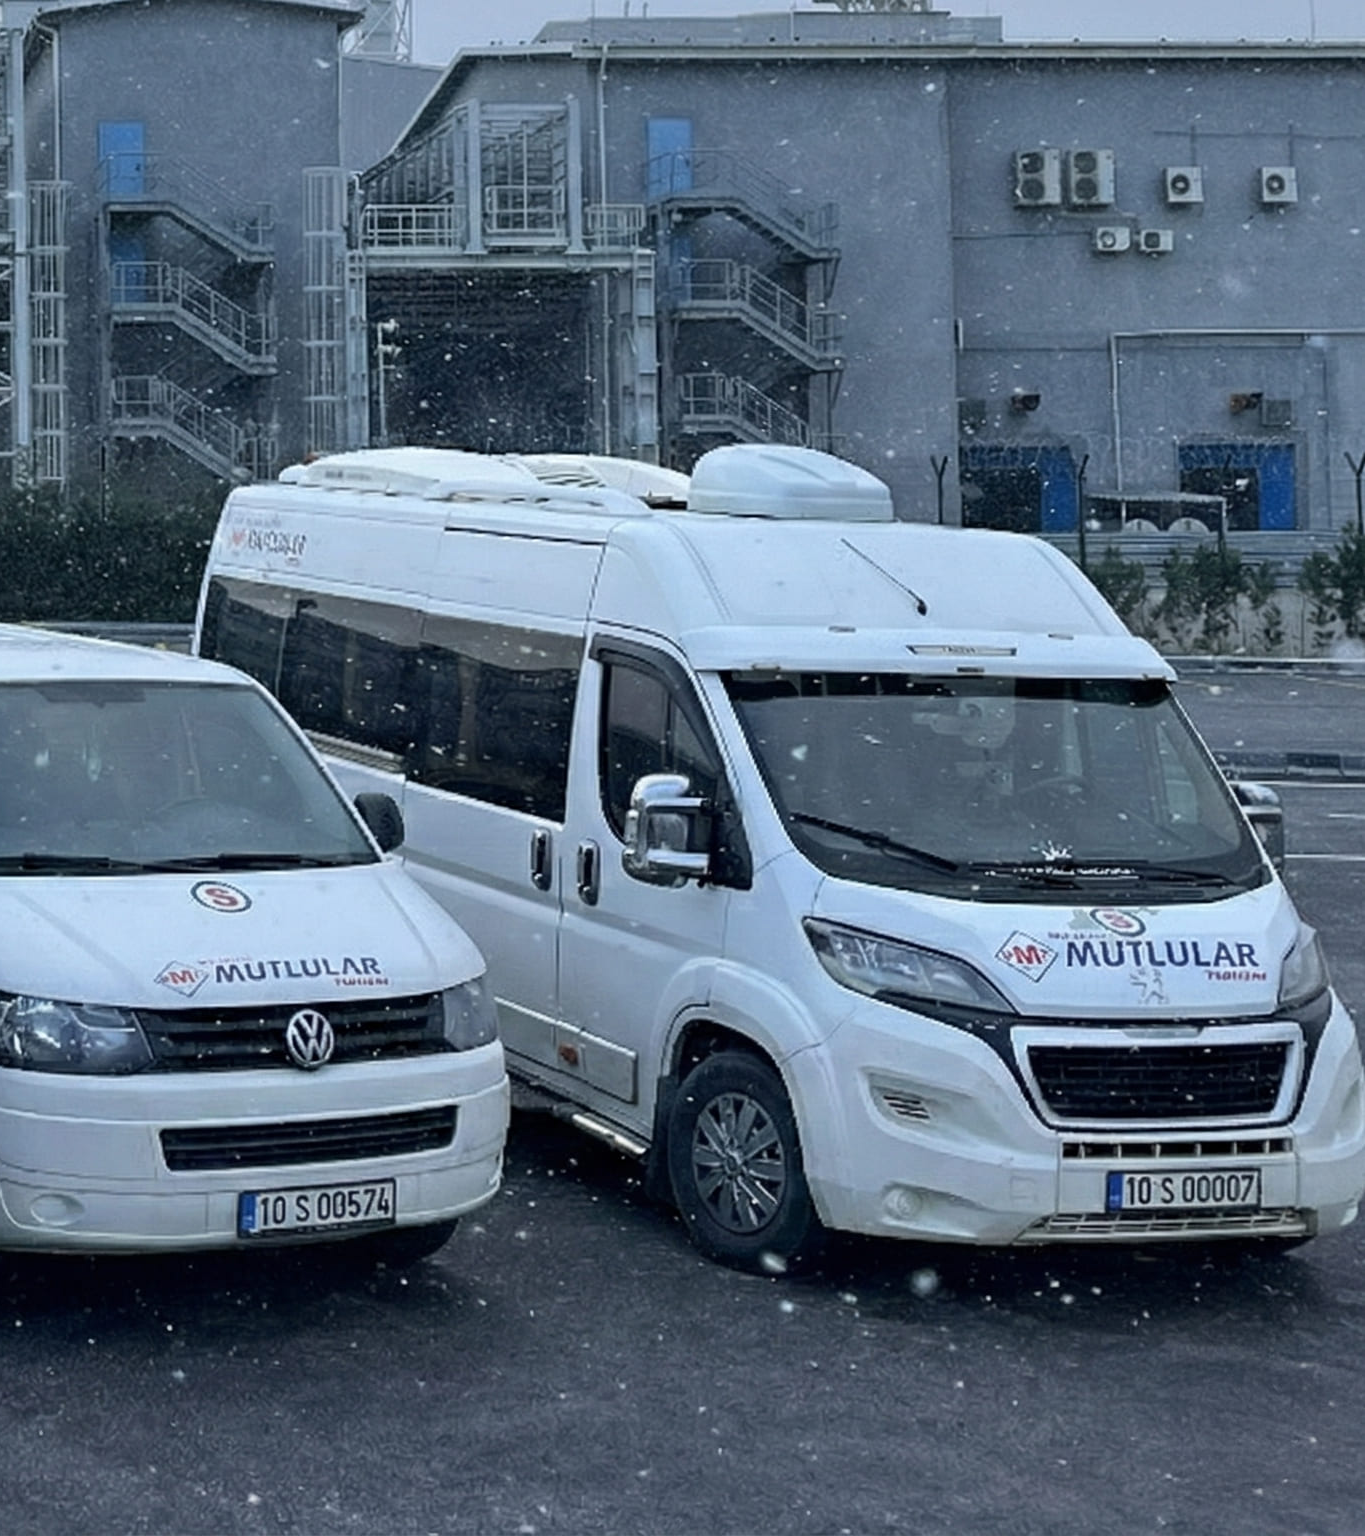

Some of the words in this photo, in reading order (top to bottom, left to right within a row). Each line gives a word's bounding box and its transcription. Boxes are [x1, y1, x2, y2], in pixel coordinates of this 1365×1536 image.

[205, 887, 238, 907] S
[1066, 940, 1259, 968] MUTLULAR
[215, 957, 381, 984] MUTLULAR
[1126, 1176, 1151, 1206] 10
[1161, 1177, 1175, 1204] S
[1182, 1174, 1254, 1203] 00007
[260, 1196, 286, 1226] 10
[296, 1195, 310, 1222] S
[317, 1187, 389, 1221] 00574
